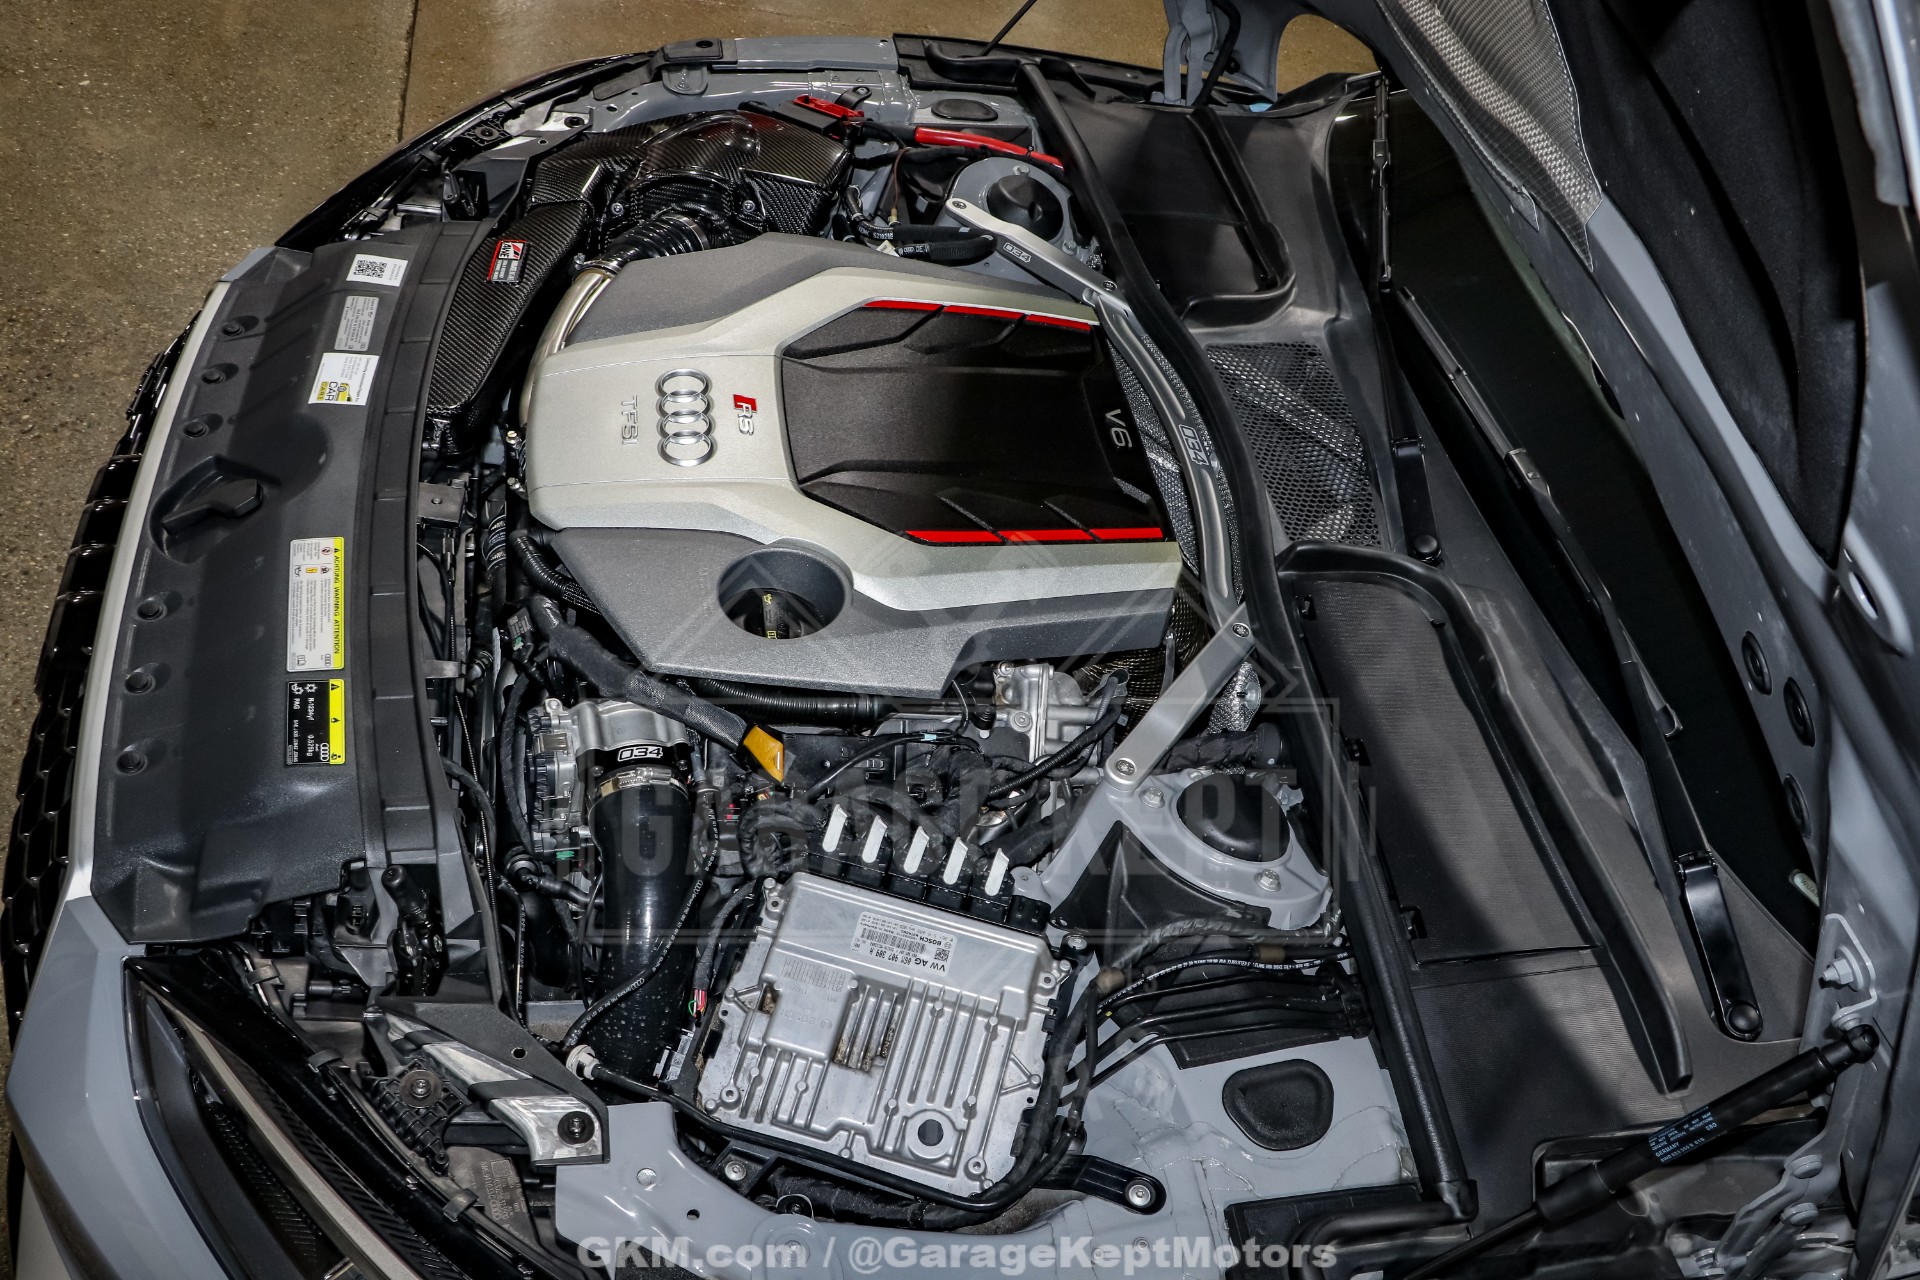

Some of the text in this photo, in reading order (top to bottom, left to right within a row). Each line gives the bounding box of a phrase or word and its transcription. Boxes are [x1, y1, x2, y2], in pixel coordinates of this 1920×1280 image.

[1003, 242, 1032, 263] 034
[317, 381, 327, 401] CARE
[325, 381, 338, 401] CAR
[621, 395, 639, 446] TFSI
[1105, 408, 1132, 448] V6
[1179, 424, 1210, 466] 034
[617, 746, 663, 762] 034
[919, 935, 942, 946] BOSCH
[914, 957, 929, 967] AG
[929, 963, 946, 972] VW
[1655, 1141, 1680, 1157] GERMANY
